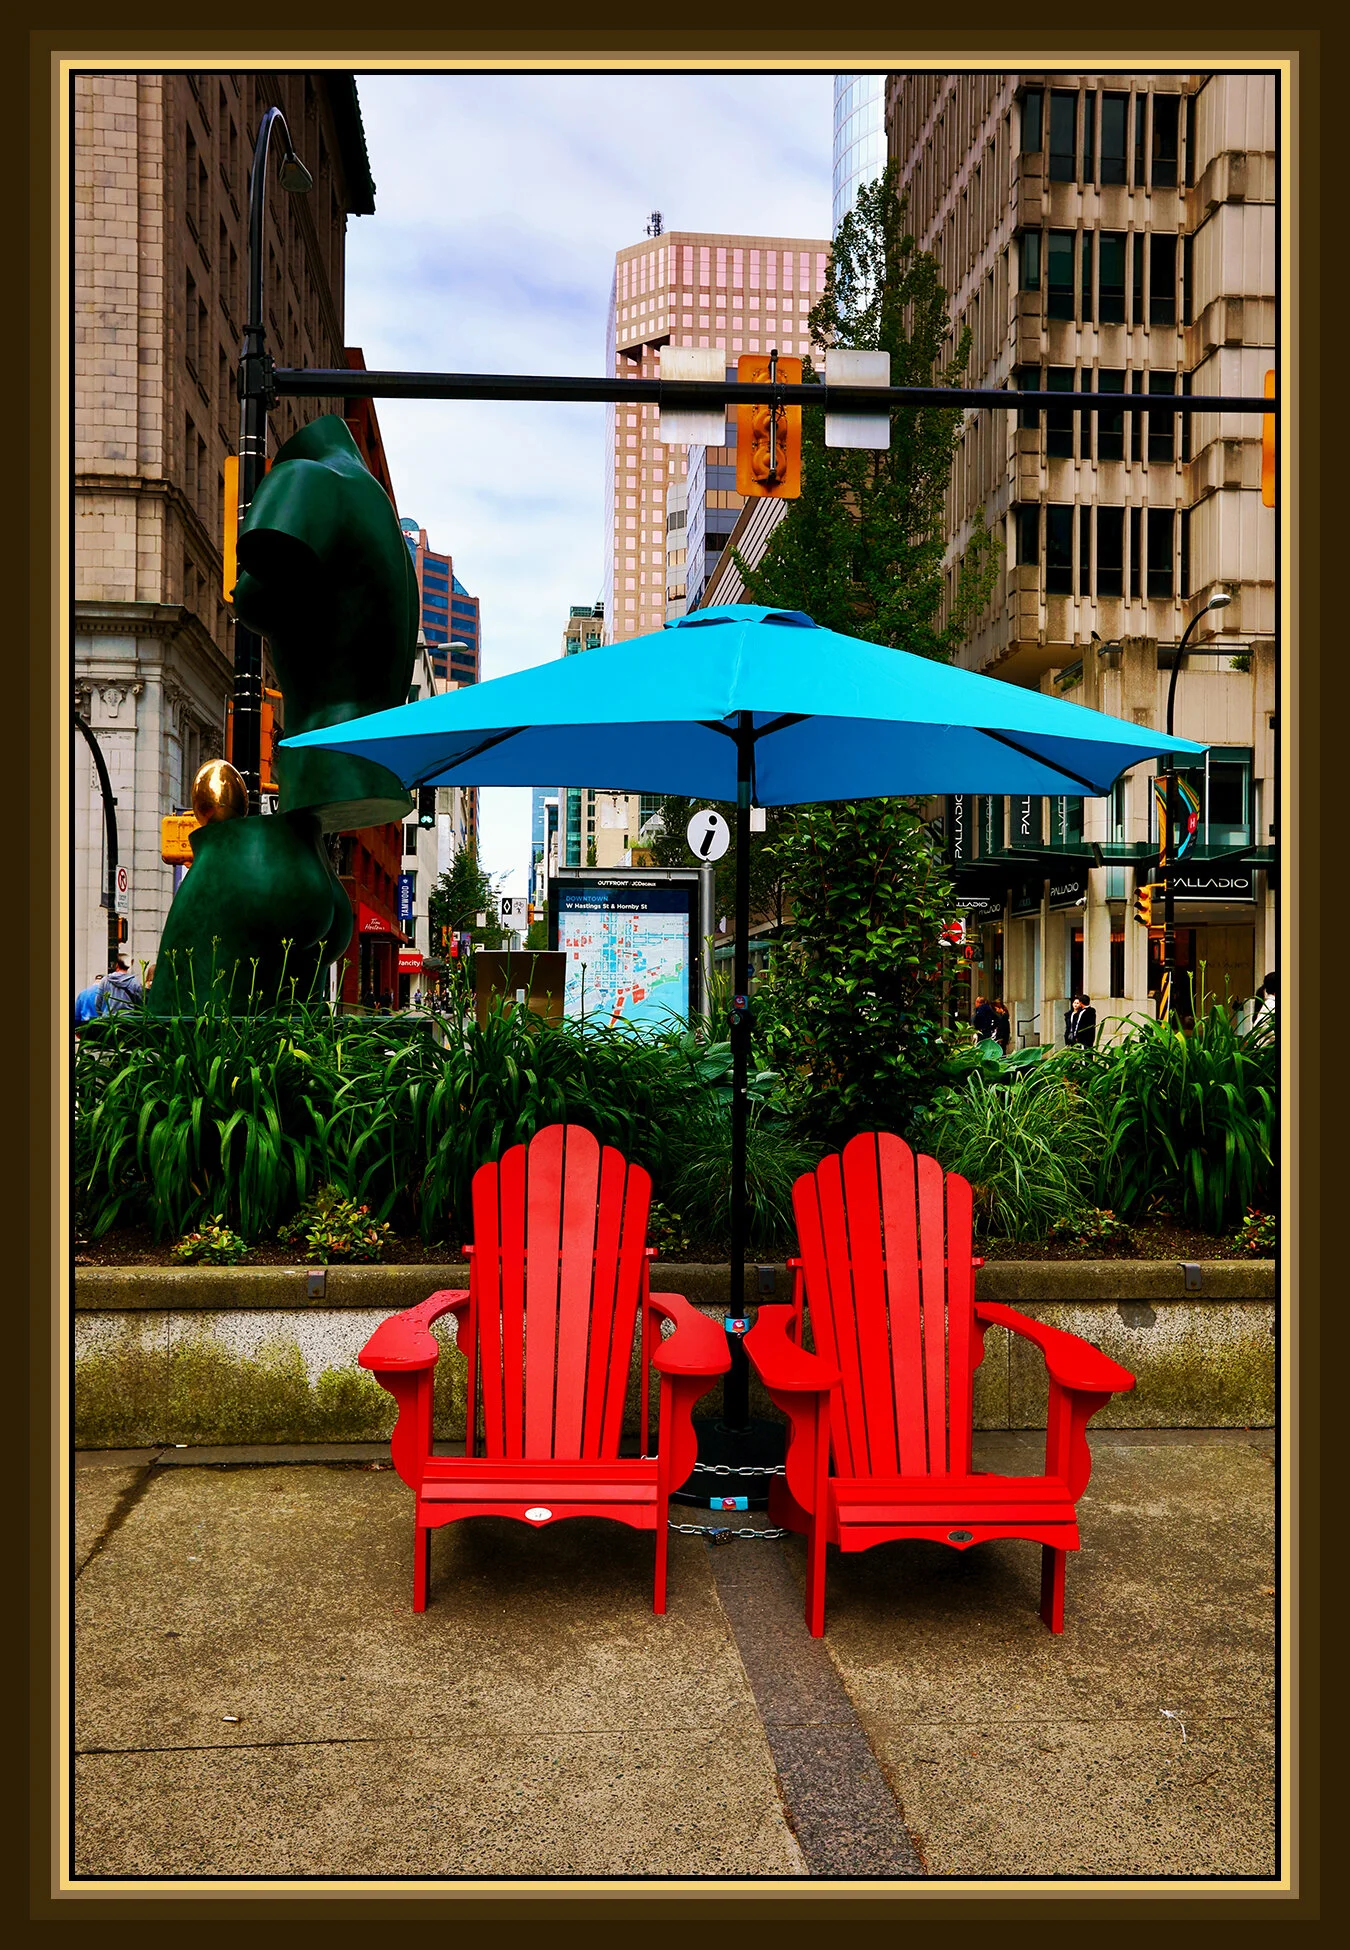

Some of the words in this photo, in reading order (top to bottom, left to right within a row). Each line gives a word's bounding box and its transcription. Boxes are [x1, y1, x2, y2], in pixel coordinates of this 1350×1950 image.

[1050, 882, 1079, 896] PALLADIO
[401, 886, 409, 917] TAMWOOD
[616, 903, 640, 911] Hornby
